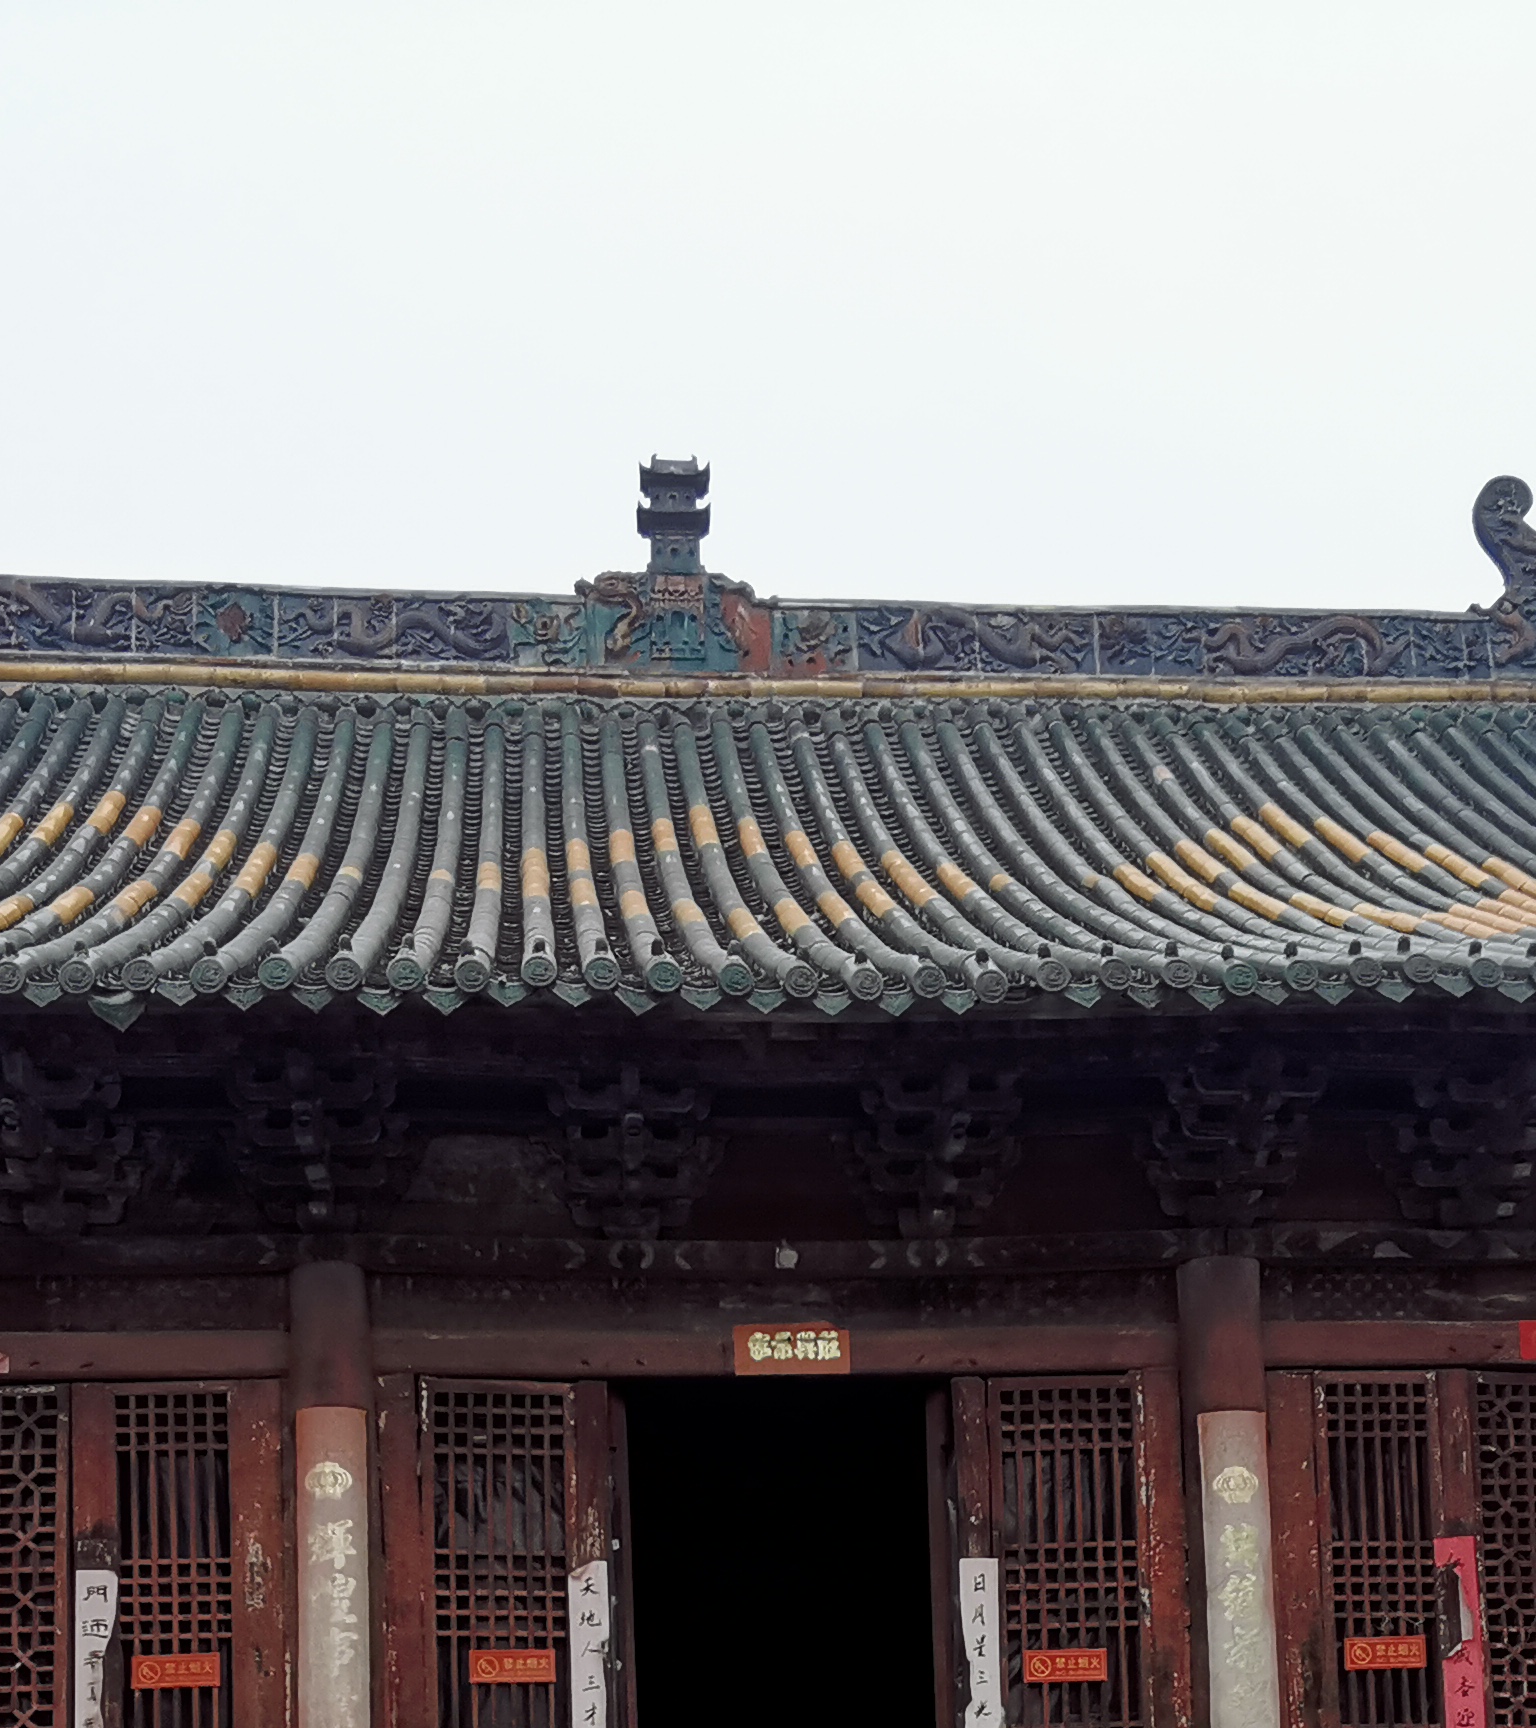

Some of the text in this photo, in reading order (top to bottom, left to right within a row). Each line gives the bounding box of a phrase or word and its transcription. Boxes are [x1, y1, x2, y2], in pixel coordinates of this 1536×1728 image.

[1375, 1643, 1420, 1656] 禁止烟火
[1055, 1656, 1101, 1669] 禁止烟火
